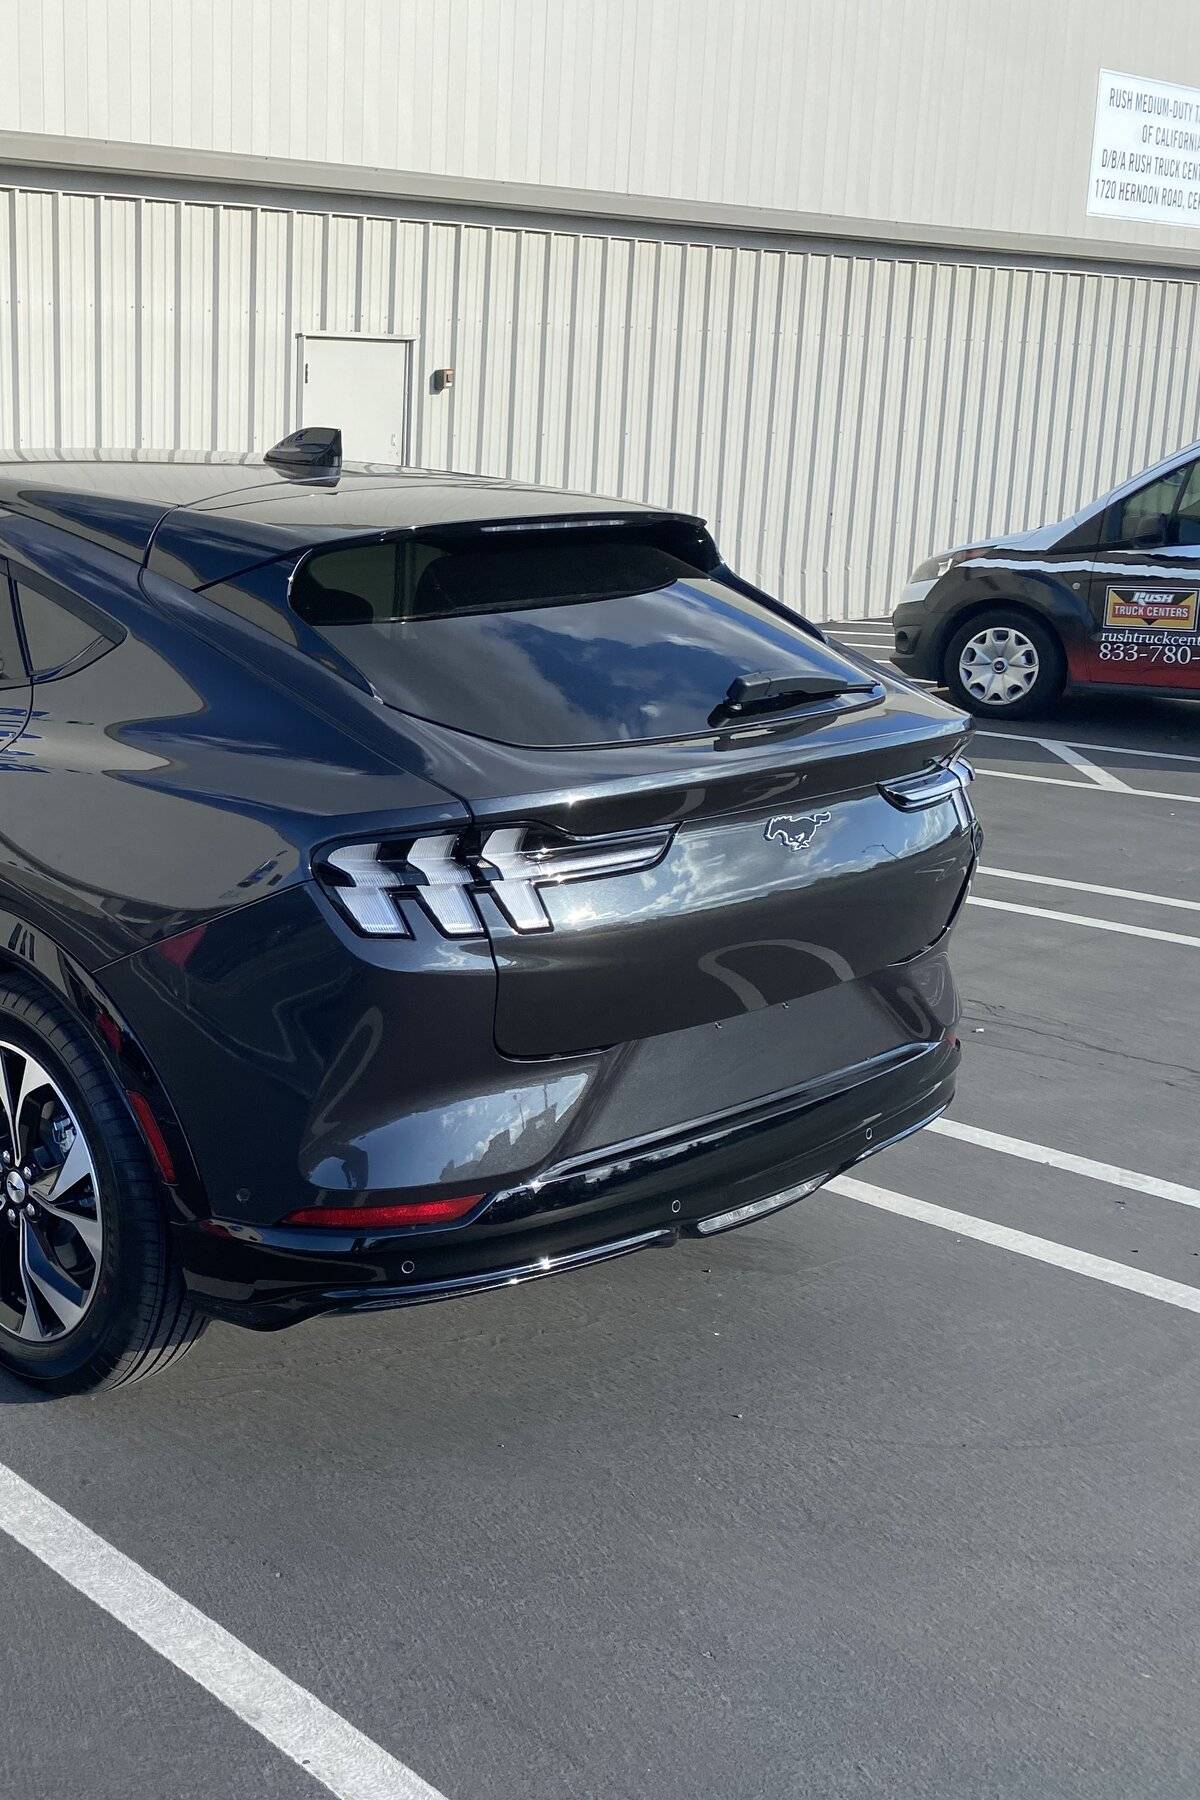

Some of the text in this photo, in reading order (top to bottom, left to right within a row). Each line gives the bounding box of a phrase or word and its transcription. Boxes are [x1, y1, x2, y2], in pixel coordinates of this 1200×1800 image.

[1109, 87, 1200, 123] RUSH MEDIUM-DUTY T
[1141, 124, 1154, 143] OF
[1101, 148, 1126, 169] D/B/A
[1128, 152, 1152, 174] RUSH
[1154, 156, 1180, 178] TRUCK
[1095, 178, 1117, 200] 1720
[1118, 181, 1159, 205] HERNDON
[1161, 187, 1185, 210] ROAD,
[1114, 605, 1189, 618] TRUCK CENTERS
